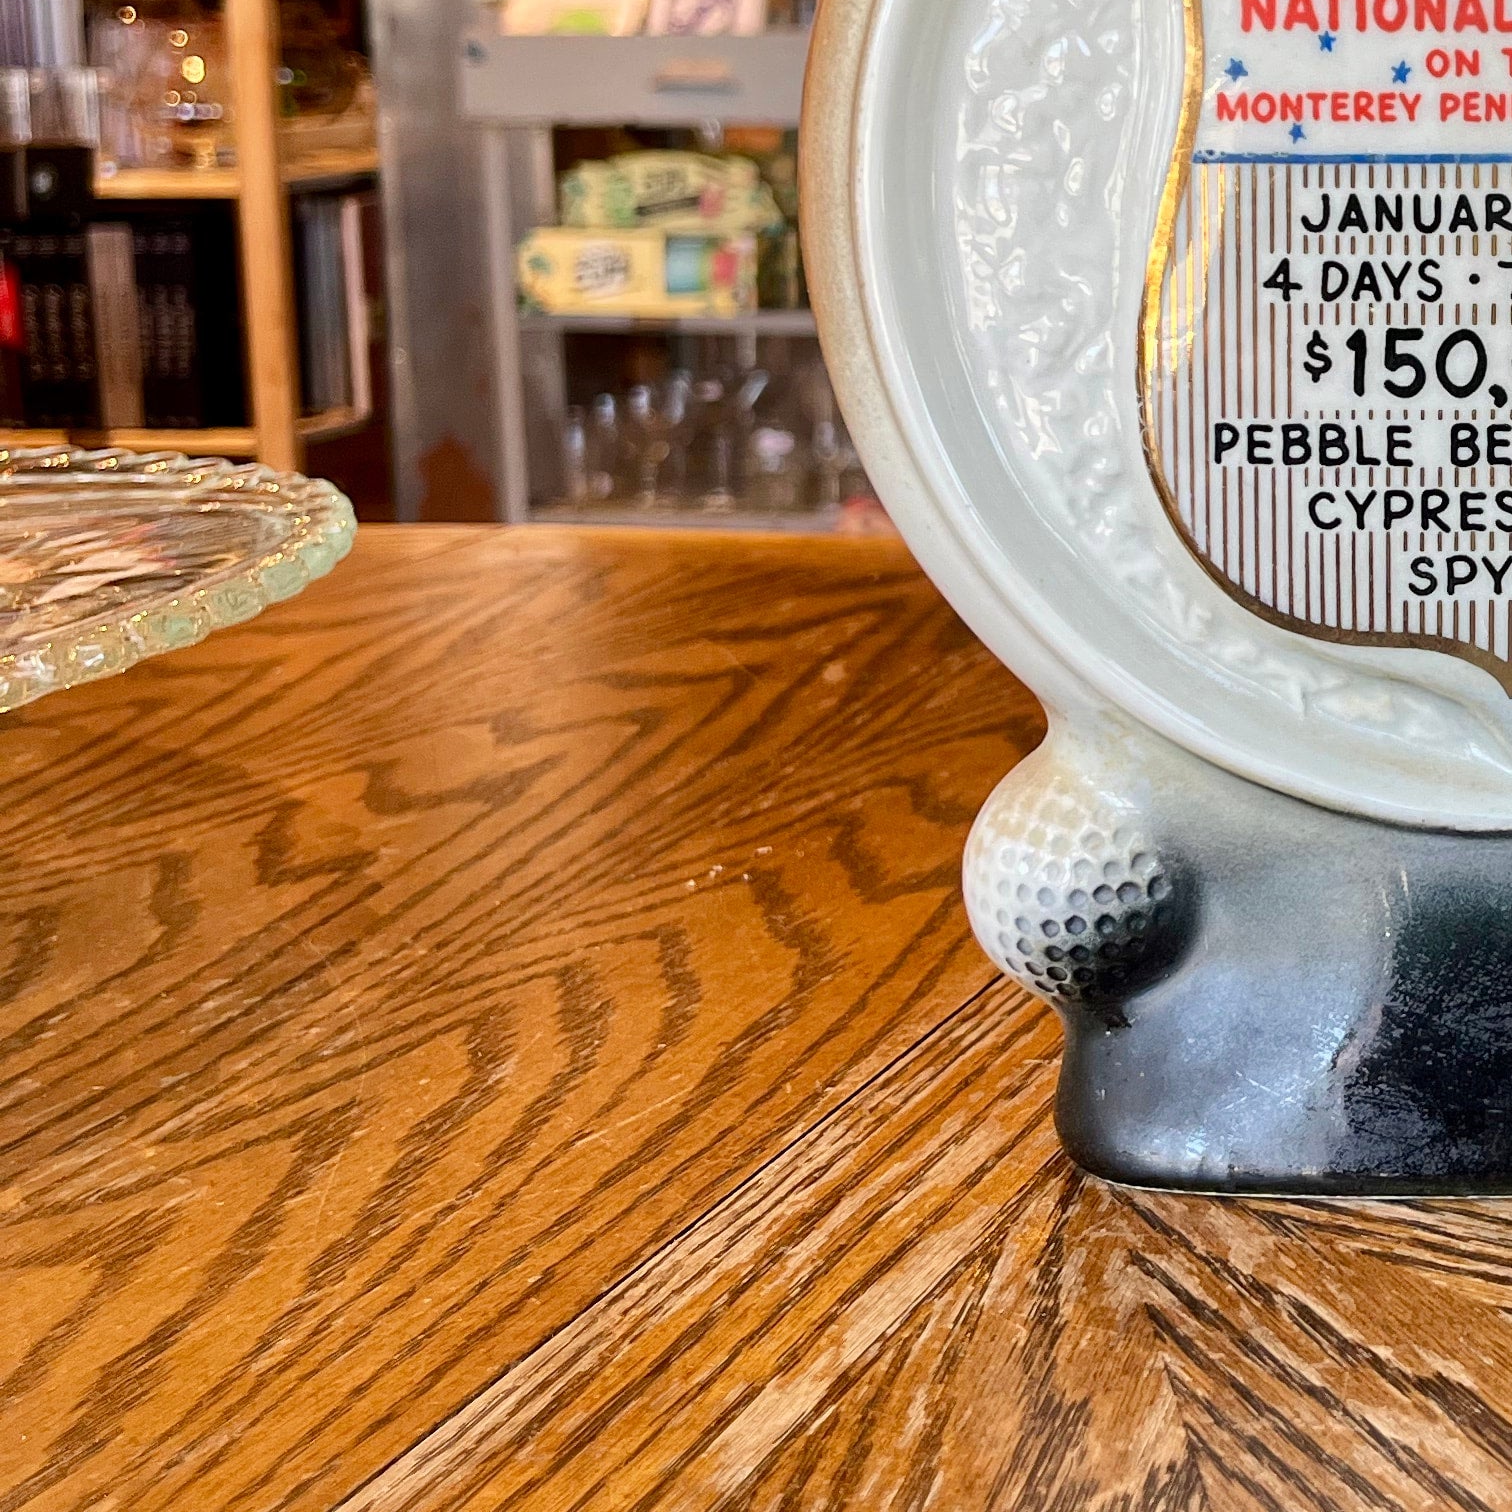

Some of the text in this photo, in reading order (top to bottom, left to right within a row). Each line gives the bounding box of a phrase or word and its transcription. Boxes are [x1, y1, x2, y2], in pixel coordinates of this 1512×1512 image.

[1426, 49, 1479, 78] ON
[1217, 91, 1421, 123] MONTEREY
[1263, 258, 1302, 301] 4
[1321, 259, 1442, 302] DAYS
[1215, 423, 1413, 467] PEBBLE
